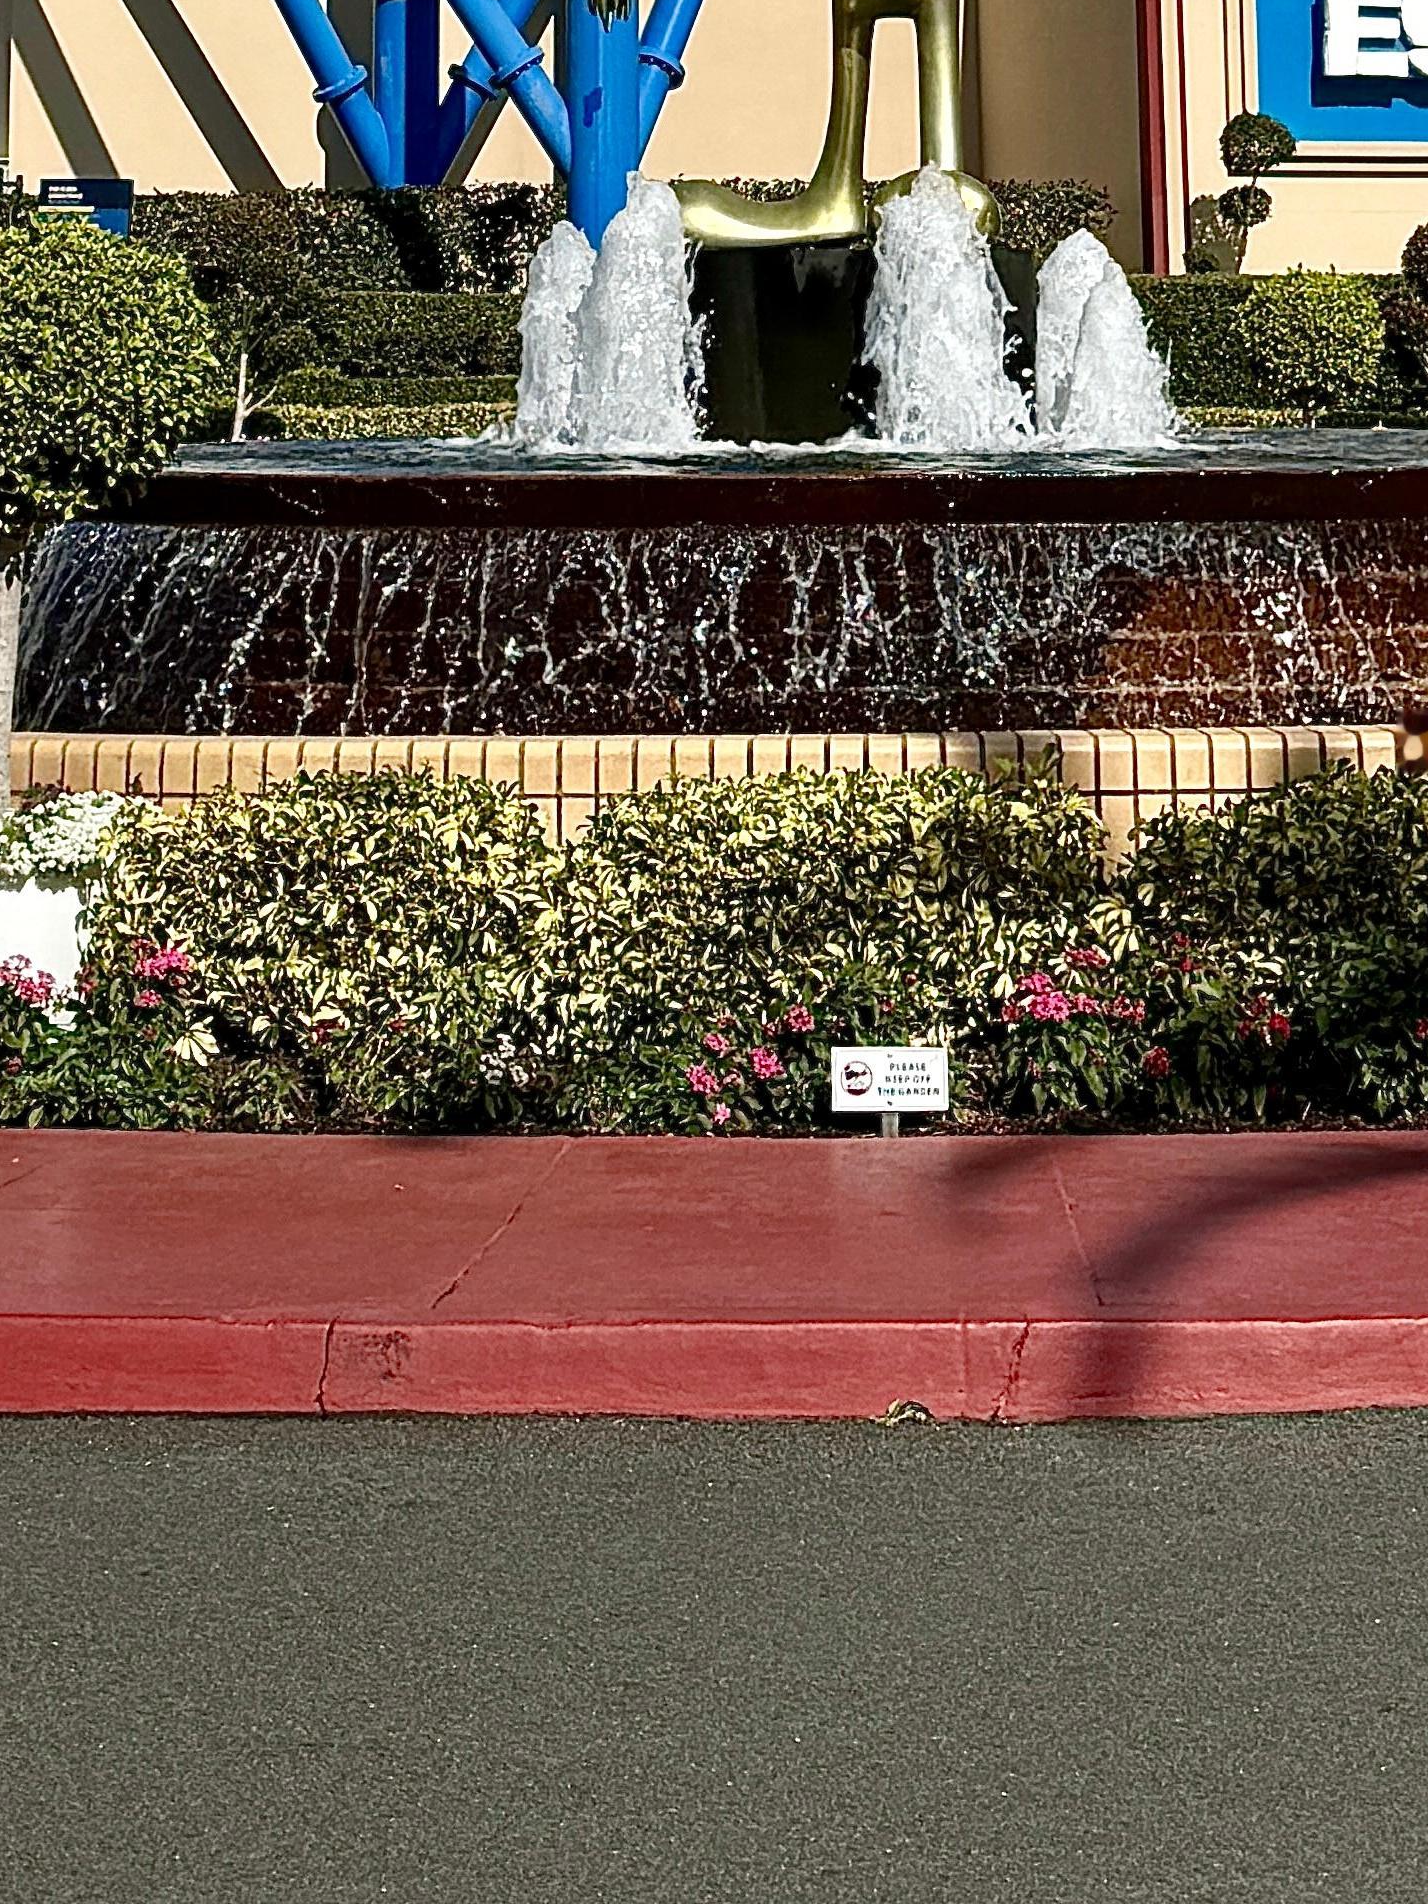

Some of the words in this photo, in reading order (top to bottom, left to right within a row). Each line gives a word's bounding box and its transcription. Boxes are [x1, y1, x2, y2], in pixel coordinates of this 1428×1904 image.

[889, 1062, 926, 1072] PLEASE
[885, 1074, 910, 1084] KEEP
[877, 1086, 896, 1097] THE
[898, 1087, 940, 1097] GARDEN
